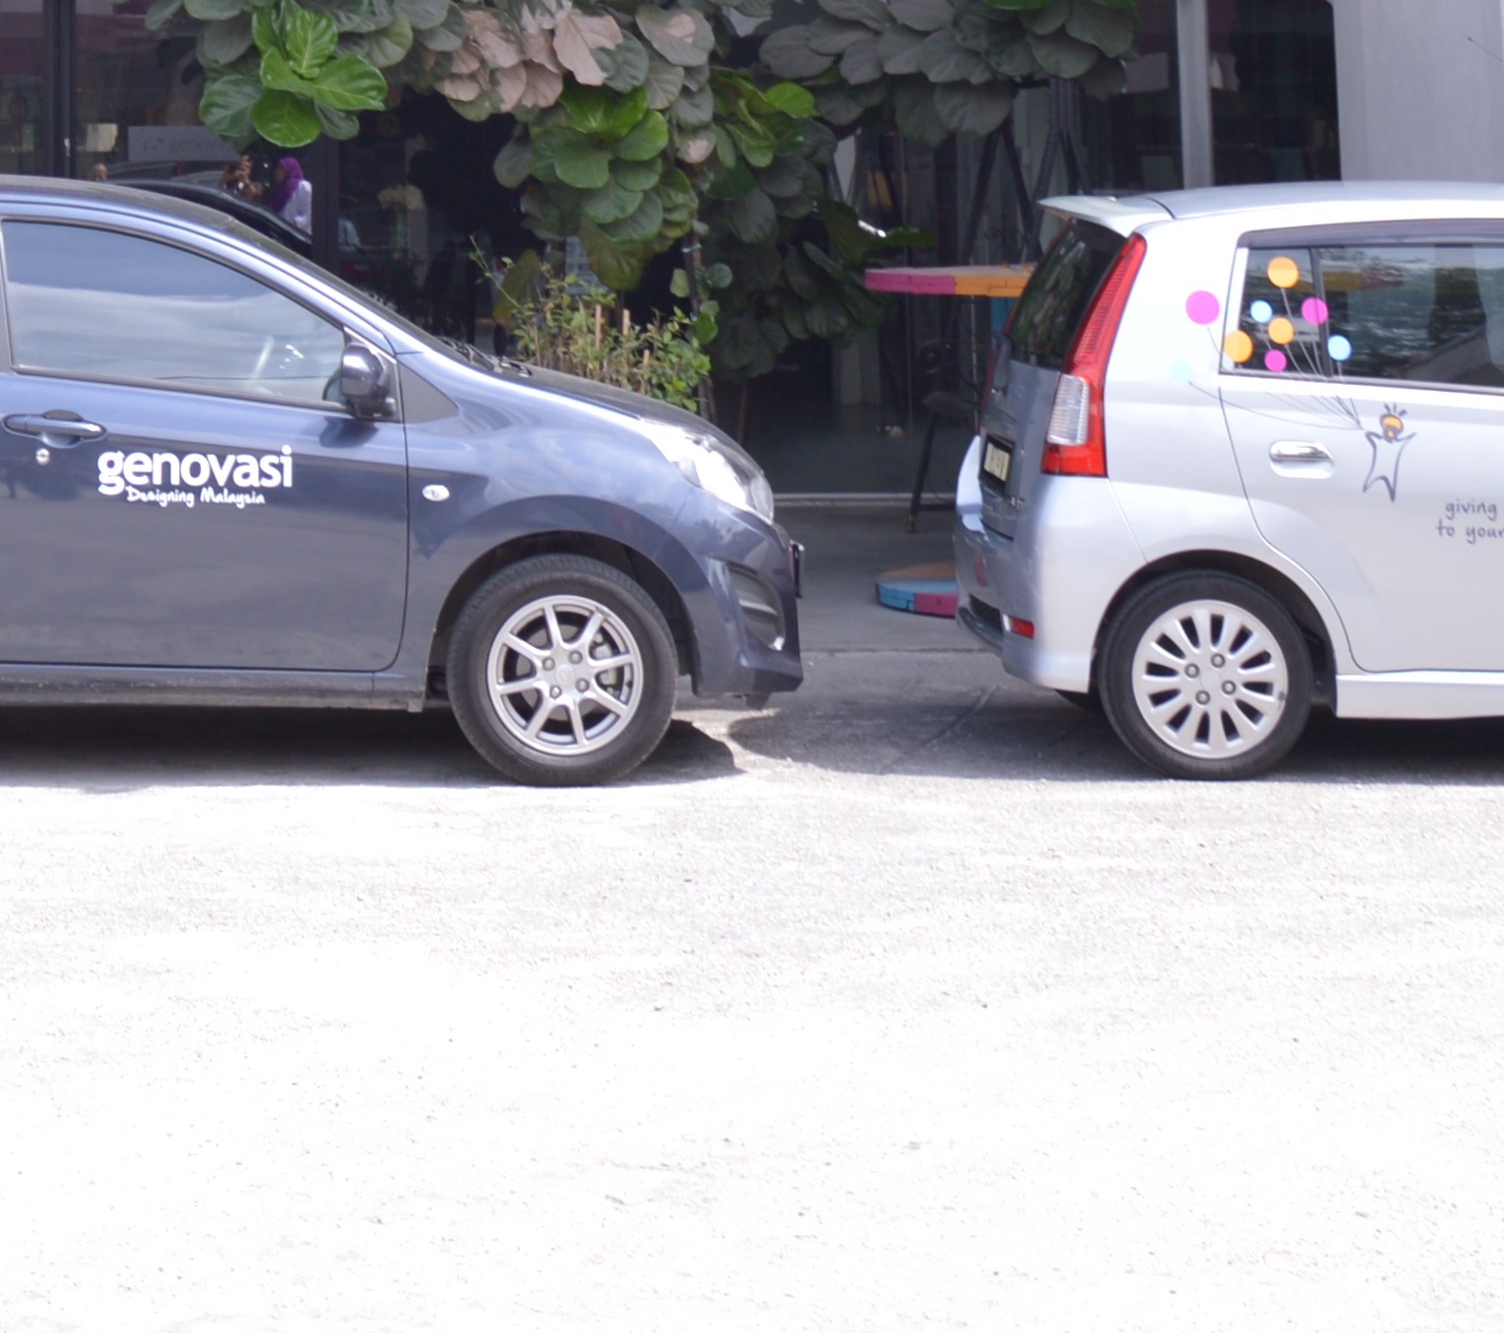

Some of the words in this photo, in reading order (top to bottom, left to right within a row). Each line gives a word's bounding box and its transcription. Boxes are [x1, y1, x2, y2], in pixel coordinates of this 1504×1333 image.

[97, 444, 293, 496] genovasi
[125, 485, 195, 508] Designing
[199, 485, 266, 509] Malaysia
[1444, 497, 1498, 522] giving
[1435, 518, 1456, 537] to
